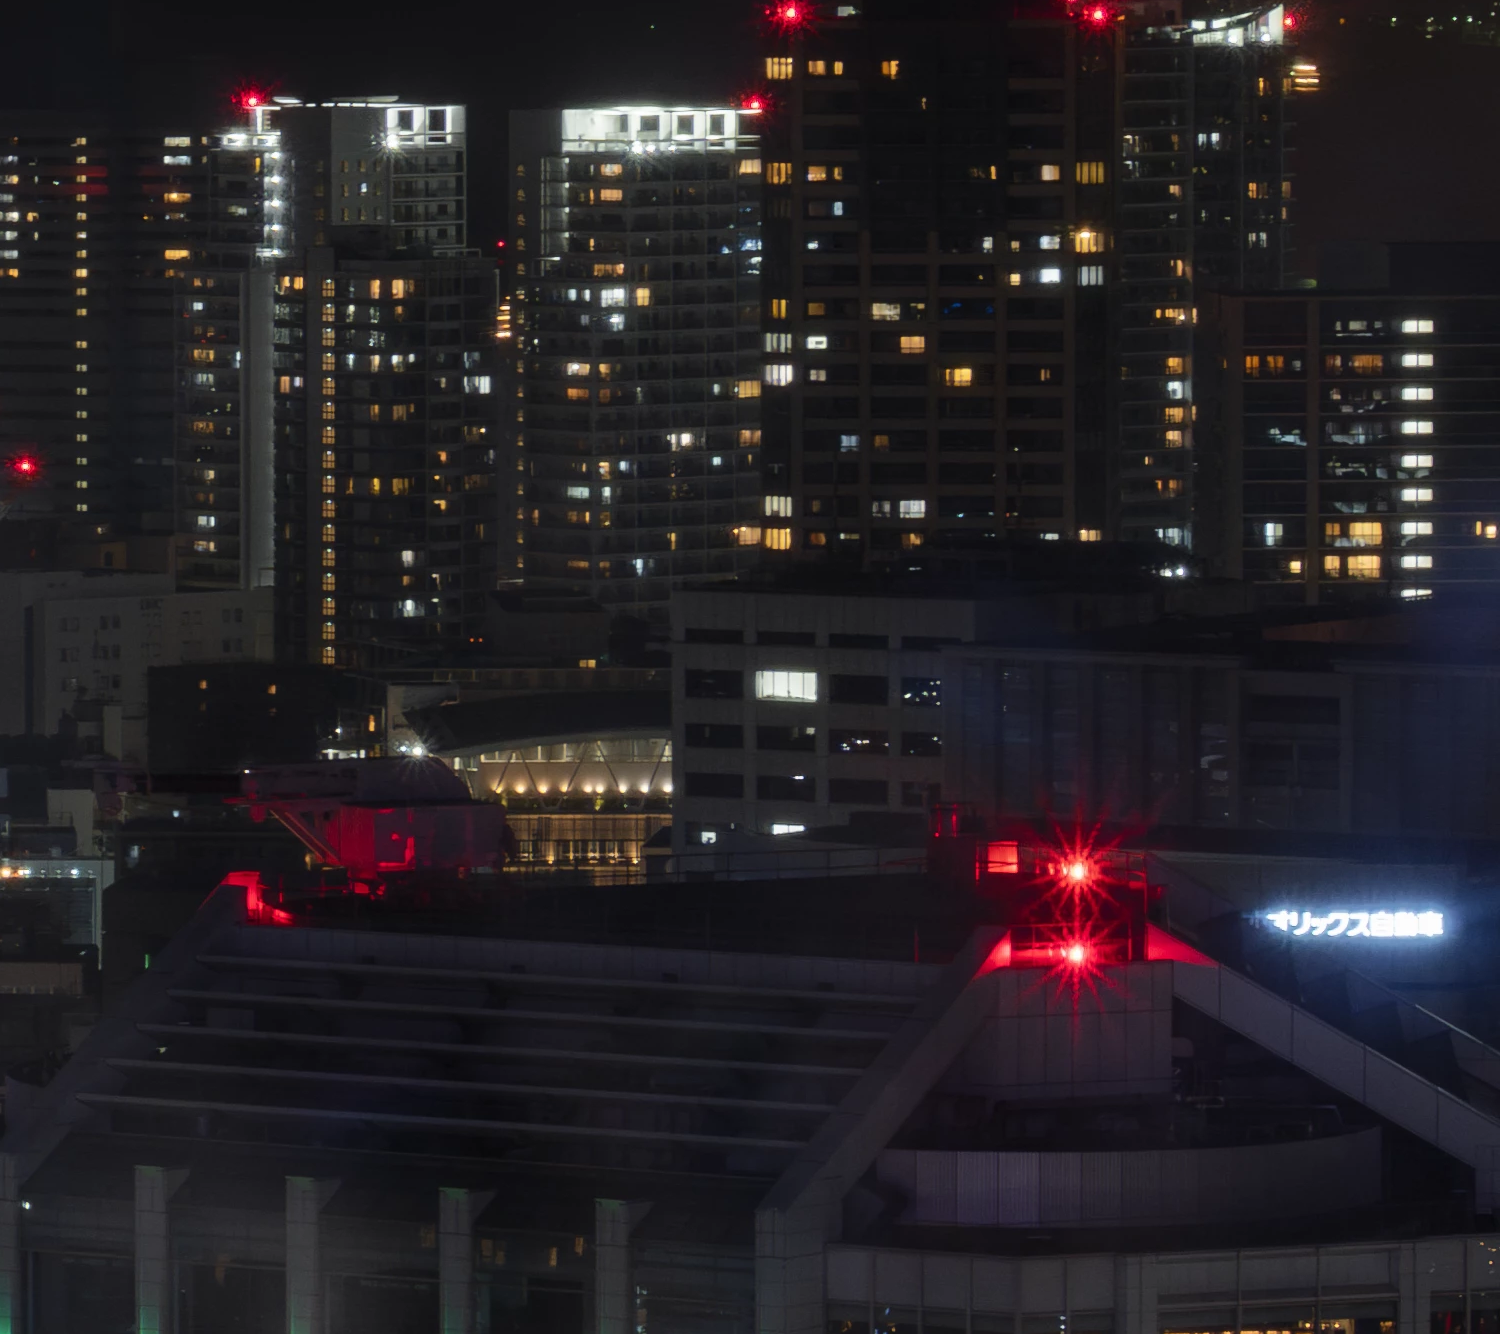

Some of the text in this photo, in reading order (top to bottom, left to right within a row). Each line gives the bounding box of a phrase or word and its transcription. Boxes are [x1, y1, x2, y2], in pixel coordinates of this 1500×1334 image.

[1267, 910, 1443, 936] オリックス自動車
